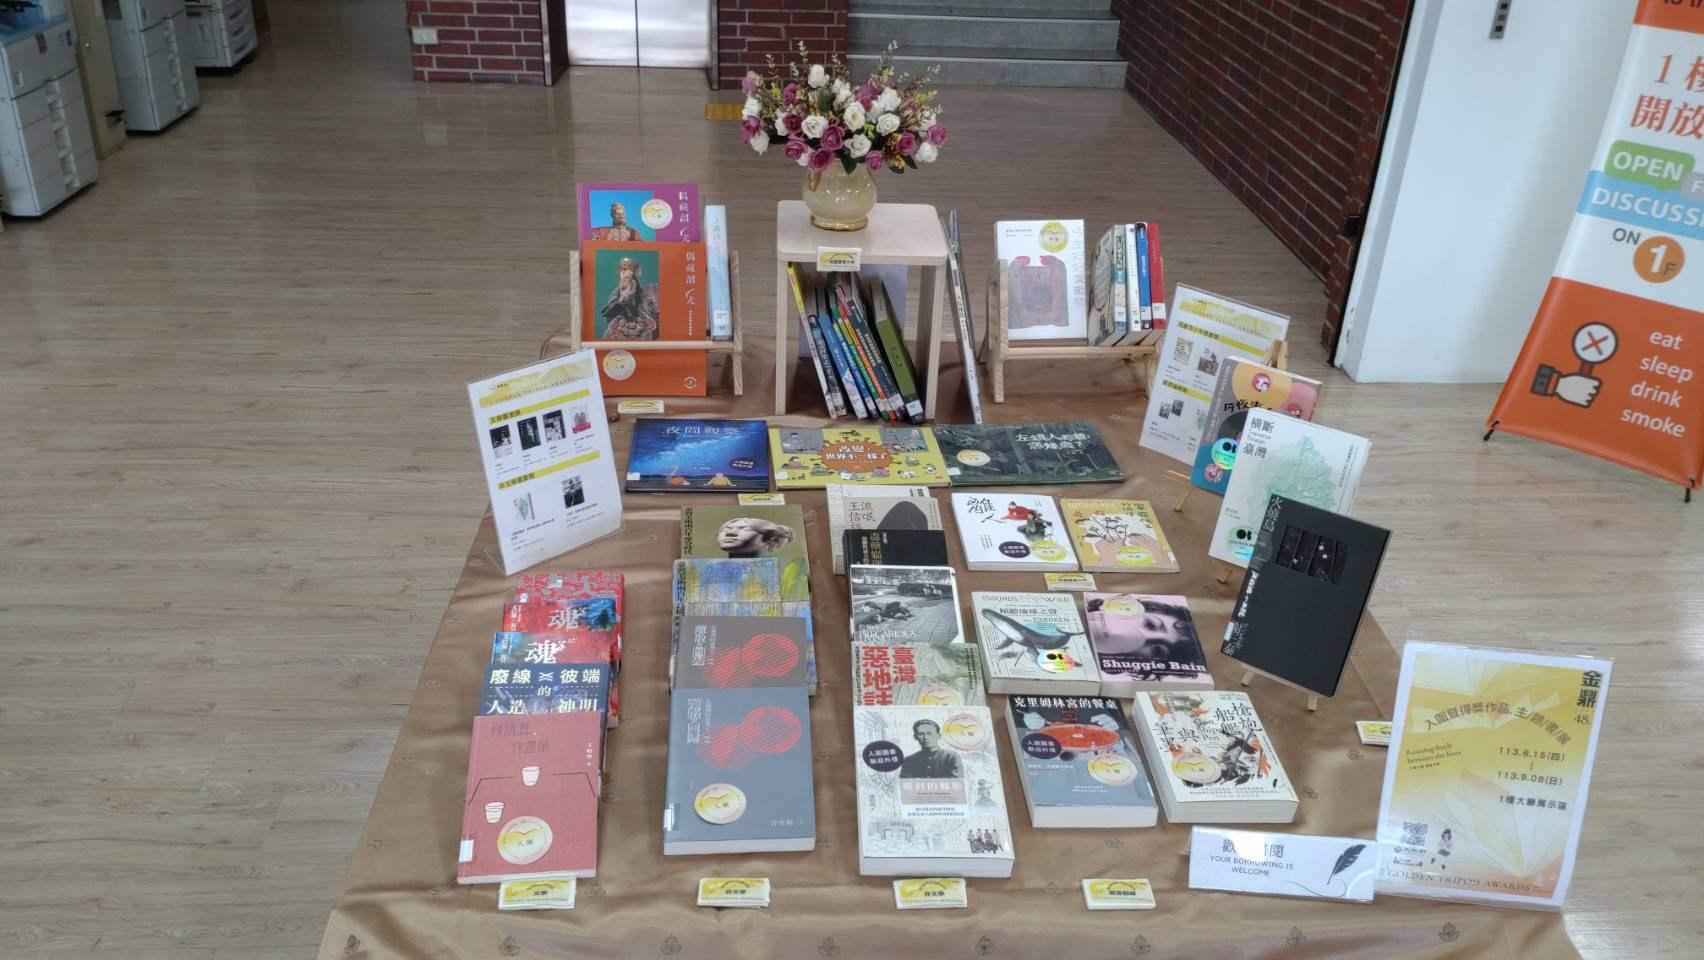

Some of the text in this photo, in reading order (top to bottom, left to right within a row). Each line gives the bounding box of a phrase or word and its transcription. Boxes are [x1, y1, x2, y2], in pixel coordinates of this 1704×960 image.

[1613, 152, 1684, 181] OPEN
[1612, 228, 1640, 245] ON
[1650, 332, 1684, 350] eat
[1640, 356, 1692, 383] sleep
[1631, 381, 1682, 407] drink
[1621, 409, 1685, 437] smoke
[1102, 659, 1207, 672] Shuggie Bain
[489, 668, 600, 684] 廢線 彼端
[537, 685, 552, 696] 的
[1577, 670, 1602, 708] 金鼎
[487, 699, 524, 715] 人造
[1014, 697, 1118, 709] 克里姆林宮的餐桌
[1497, 771, 1563, 786] 113.9.08(日)
[1500, 796, 1568, 811] 1樓大廳展示區
[1222, 838, 1284, 858] 歡閱
[1210, 855, 1231, 863] YOUR
[1231, 866, 1270, 876] WELCOME
